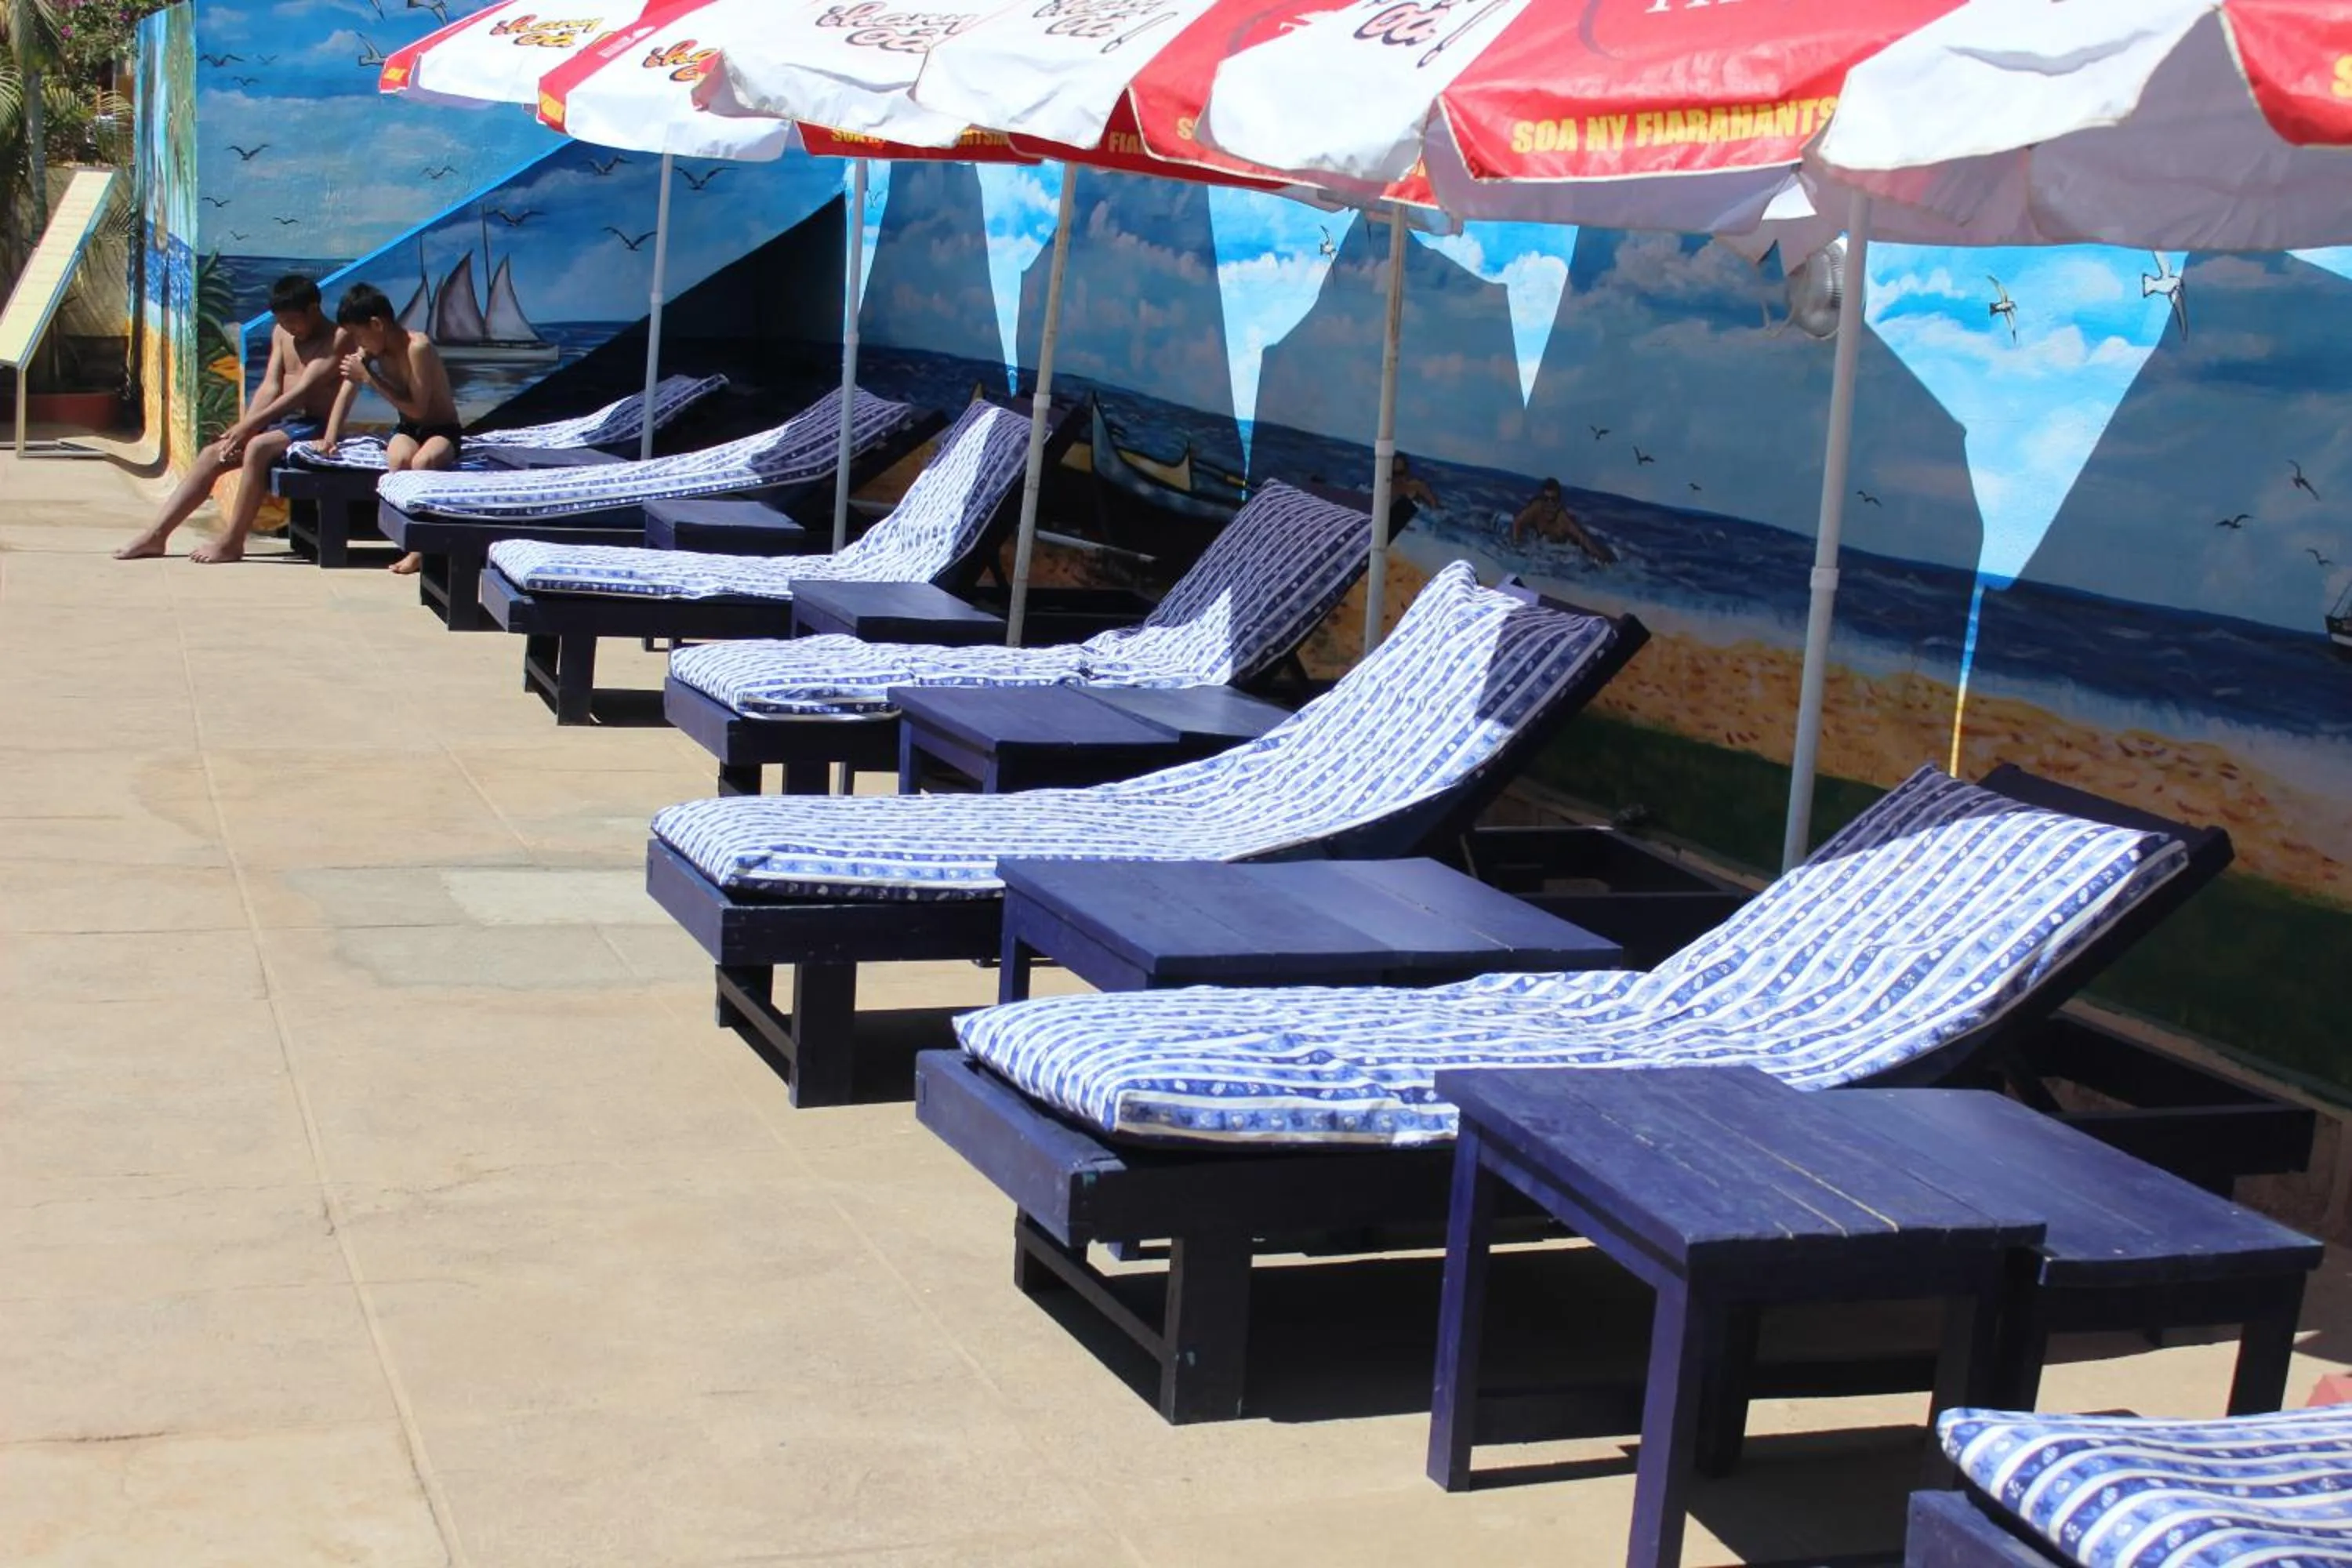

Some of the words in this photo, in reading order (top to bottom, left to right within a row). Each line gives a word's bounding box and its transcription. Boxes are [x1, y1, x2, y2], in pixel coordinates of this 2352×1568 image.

[1510, 118, 1579, 154] SOA
[1585, 114, 1628, 152] NY
[1634, 96, 1838, 148] FIARAHANTS
